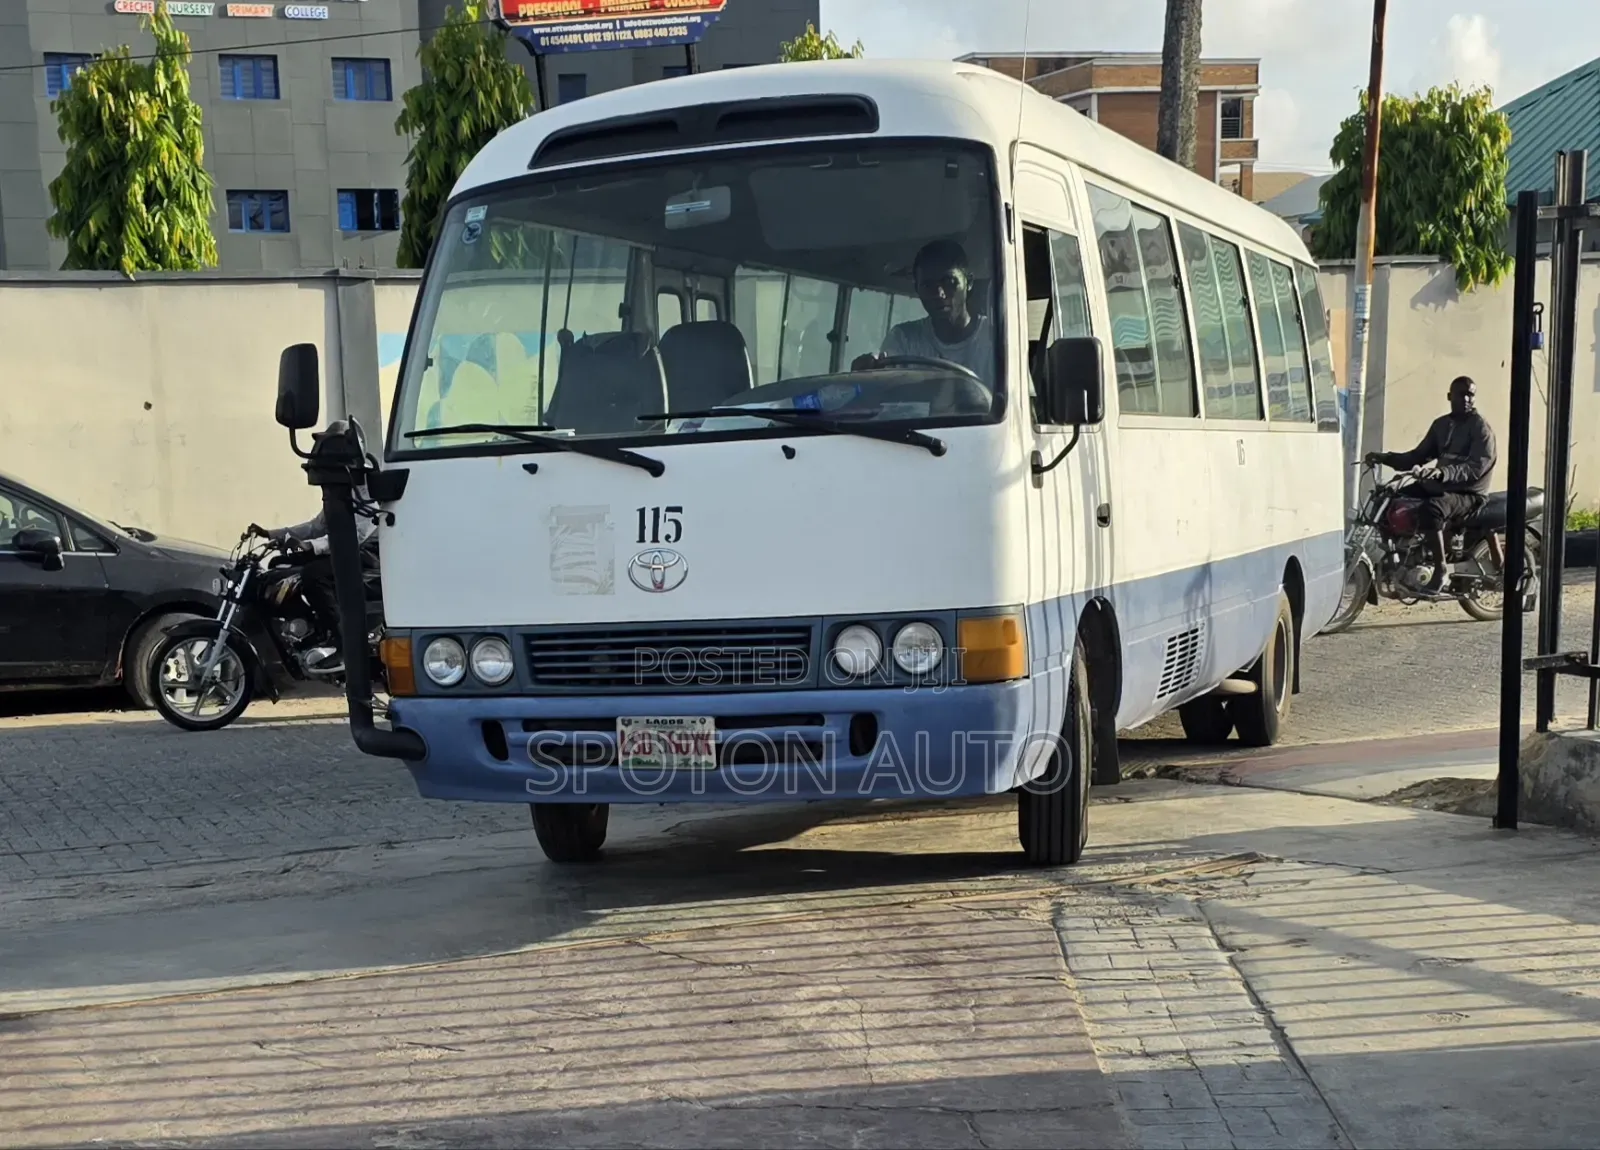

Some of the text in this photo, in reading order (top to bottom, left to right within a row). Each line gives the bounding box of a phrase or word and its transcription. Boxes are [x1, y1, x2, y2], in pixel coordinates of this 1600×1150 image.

[117, 1, 153, 12] CRECHE
[168, 3, 213, 15] NURSERY
[229, 4, 272, 16] PRIMARY
[286, 5, 327, 18] COLLEGE
[518, 1, 585, 17] PRESCHOOL
[636, 506, 683, 543] 115
